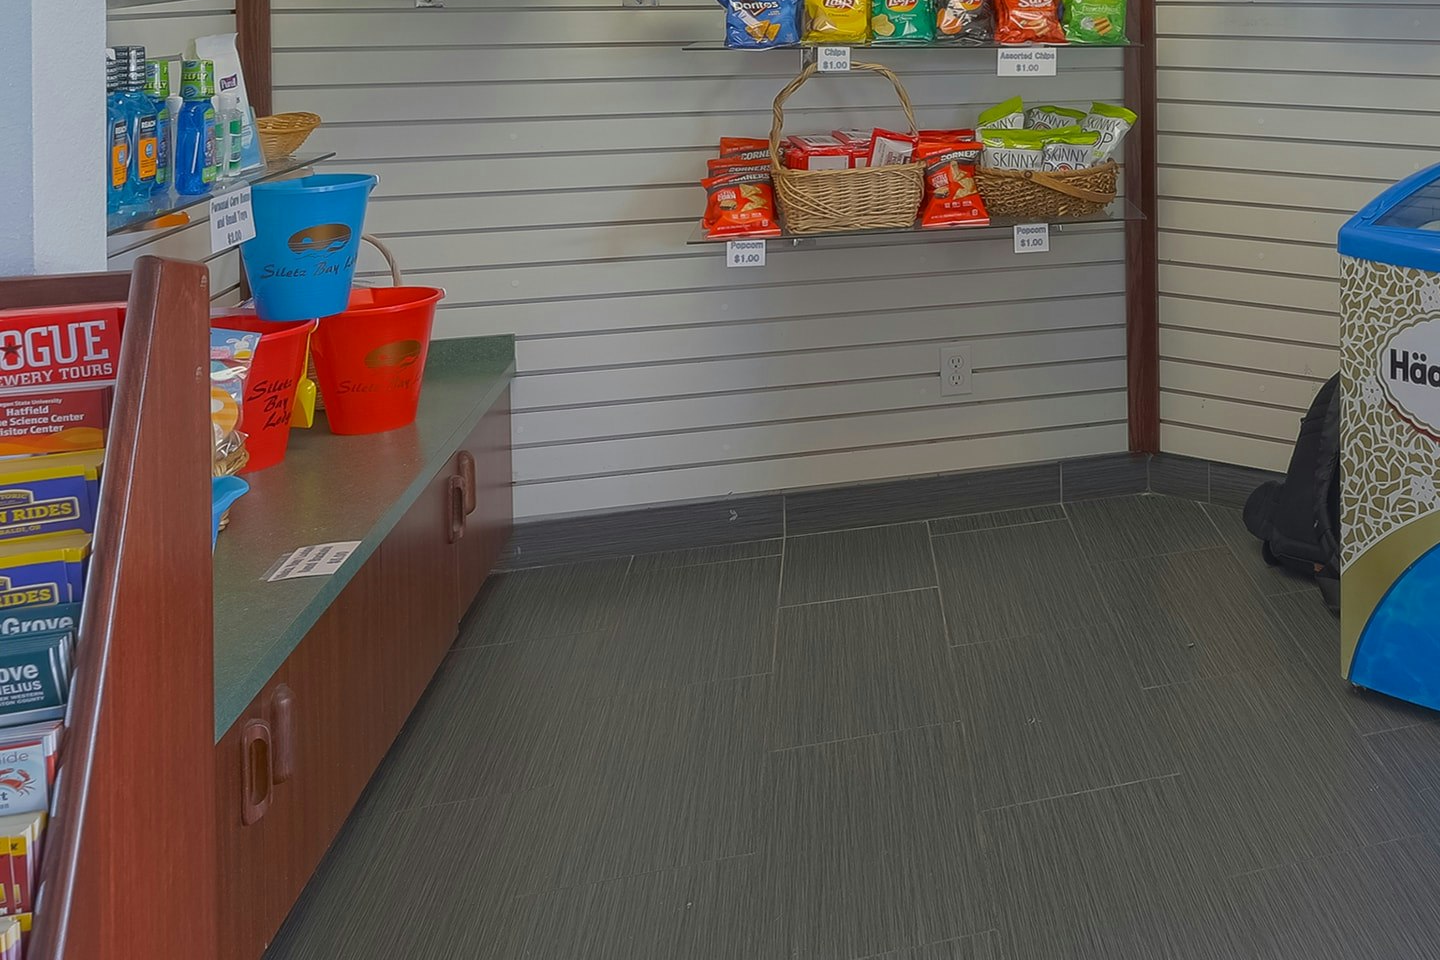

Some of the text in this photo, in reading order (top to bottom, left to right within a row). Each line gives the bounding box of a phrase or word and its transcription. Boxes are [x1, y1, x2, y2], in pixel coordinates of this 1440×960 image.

[733, 1, 779, 11] Doritos
[824, 48, 846, 58] Chips
[1000, 52, 1055, 60] Assorted Chips
[823, 61, 847, 70] $1.00
[1016, 64, 1039, 72] $1.00
[741, 147, 784, 160] CORNES
[1044, 145, 1088, 162] SKINNY
[993, 150, 1039, 168] SKINNY
[1016, 226, 1046, 235] Popcorn
[730, 241, 763, 250] Popcorn
[1020, 238, 1043, 247] $1.00
[734, 254, 760, 263] $1.00
[261, 264, 306, 279] Siletz
[313, 261, 339, 275] Bay
[58, 362, 112, 380] TOURS
[6, 406, 49, 417] Hatfield
[9, 416, 49, 426] Science
[50, 413, 85, 423] Center
[29, 425, 64, 434] Center
[12, 502, 73, 521] RIDES
[17, 695, 45, 704] COUNTY
